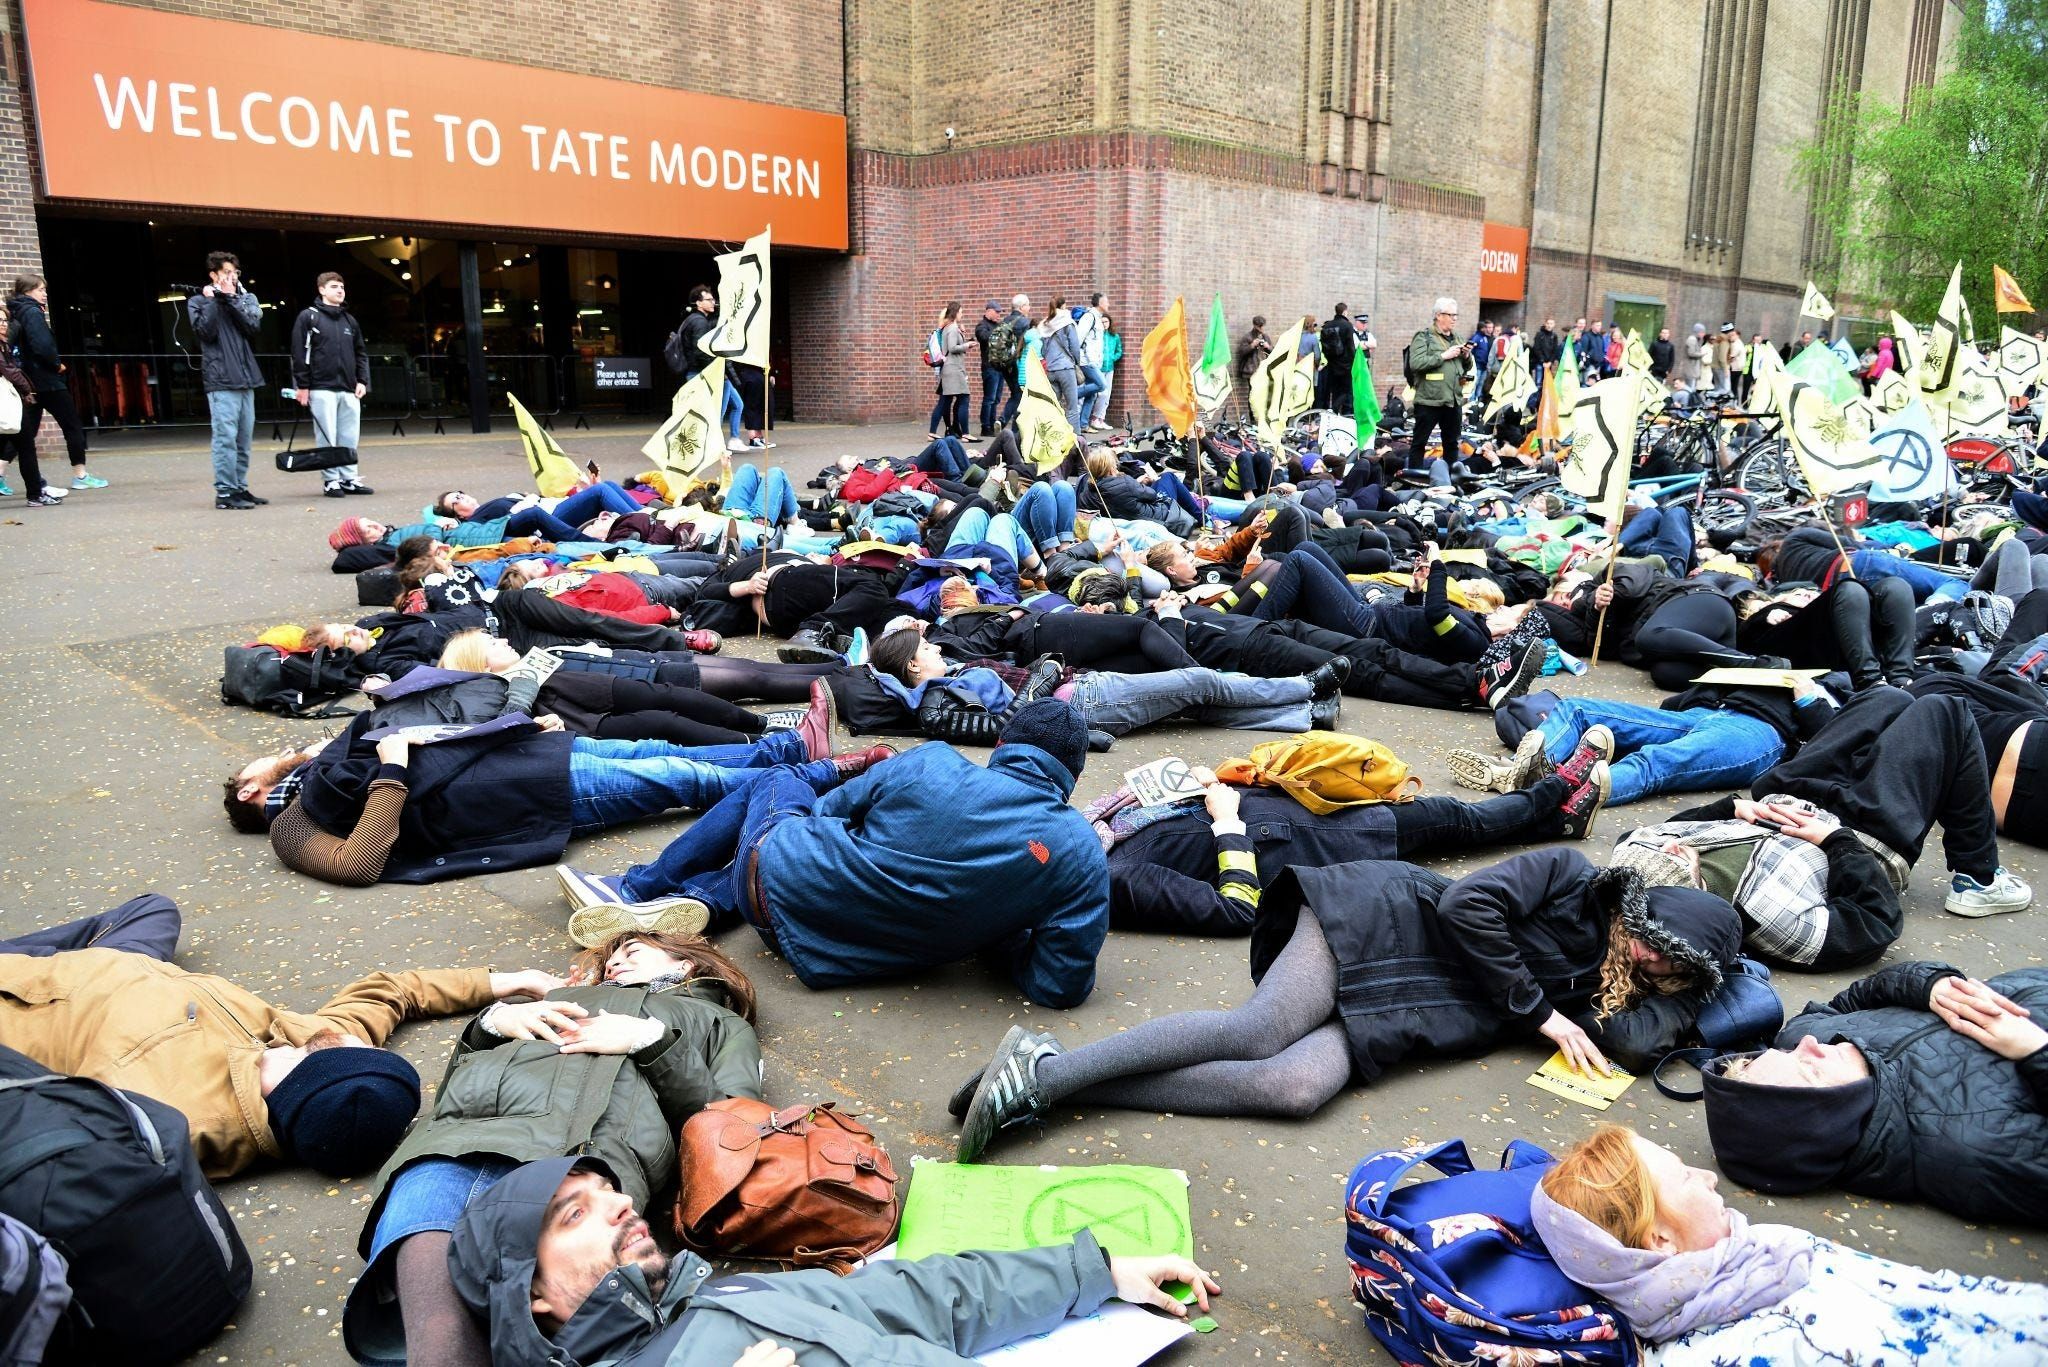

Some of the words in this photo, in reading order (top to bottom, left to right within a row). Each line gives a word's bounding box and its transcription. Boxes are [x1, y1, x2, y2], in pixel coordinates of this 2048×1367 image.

[94, 73, 413, 158] WELCOME
[433, 114, 501, 166] TO
[521, 124, 630, 180] TATE
[650, 140, 820, 199] MODERN
[1480, 248, 1519, 274] ODERN
[596, 370, 615, 379] Please
[616, 371, 627, 379] use
[628, 370, 639, 379] the
[1958, 446, 1987, 455] Santander
